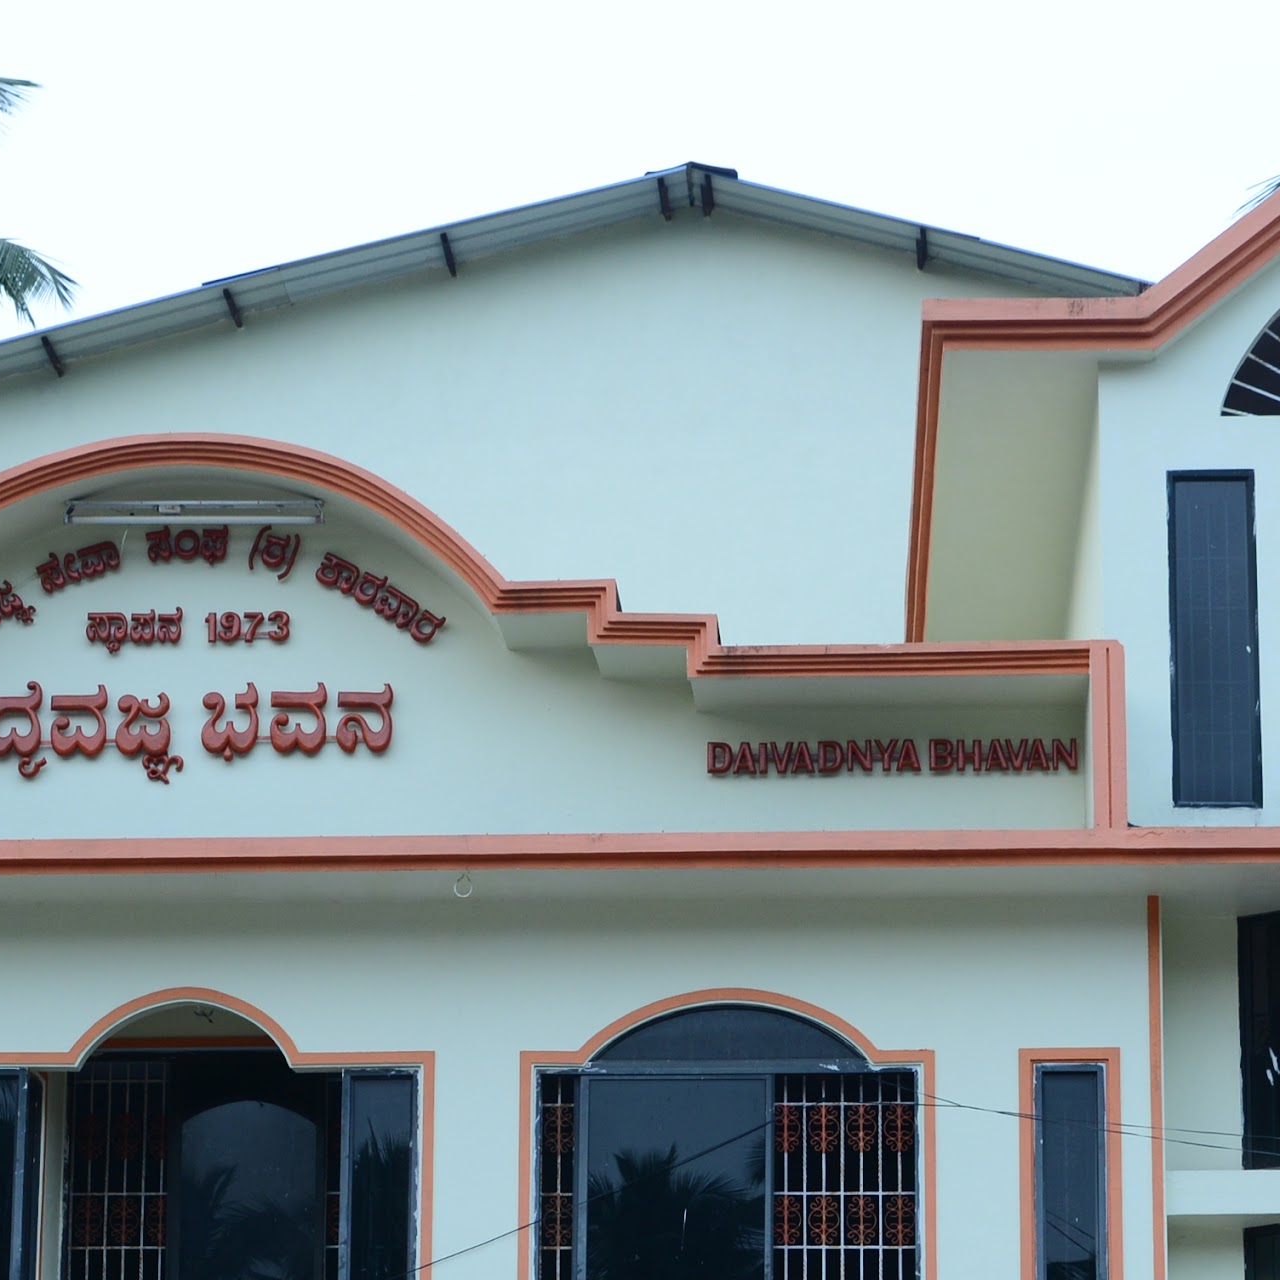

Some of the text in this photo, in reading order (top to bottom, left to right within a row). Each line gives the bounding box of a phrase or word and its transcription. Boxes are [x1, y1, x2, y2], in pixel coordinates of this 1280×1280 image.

[36, 541, 120, 593] ಸೇವಾ
[145, 525, 229, 566] ಸಂಘ
[248, 525, 300, 581] (ರ)
[315, 552, 447, 644] ಕಾರವಾರ
[205, 611, 290, 643] 1973
[201, 681, 394, 762] ಭವನ
[706, 738, 1078, 774] DAIVADNYA BHAVAN
